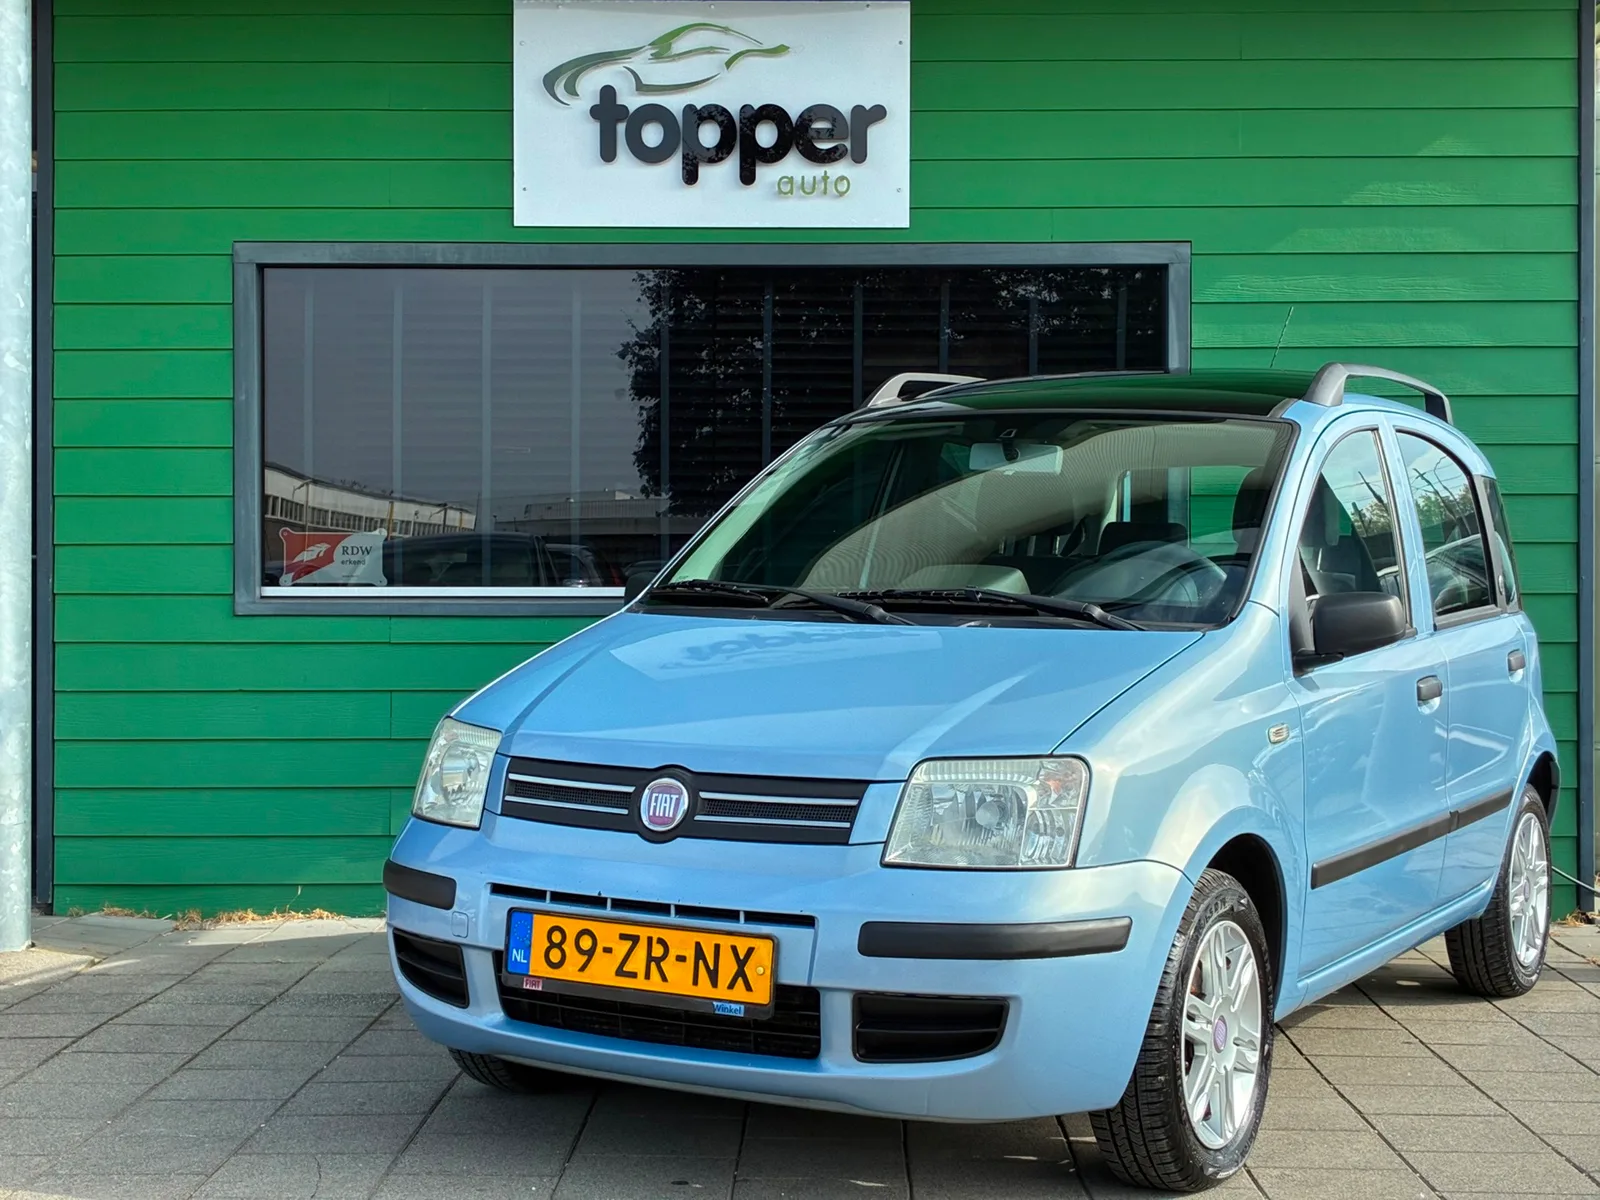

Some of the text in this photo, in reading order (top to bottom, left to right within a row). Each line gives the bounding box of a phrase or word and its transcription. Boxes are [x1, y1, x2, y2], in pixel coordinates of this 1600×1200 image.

[589, 84, 887, 186] topper
[776, 170, 851, 196] auto
[341, 545, 373, 556] RDW
[340, 558, 367, 566] erkend
[649, 792, 679, 818] FIAT
[511, 948, 528, 963] NL
[543, 924, 756, 993] 89-ZR-NX
[524, 978, 541, 989] FIAT
[712, 1003, 742, 1015] Winkel
